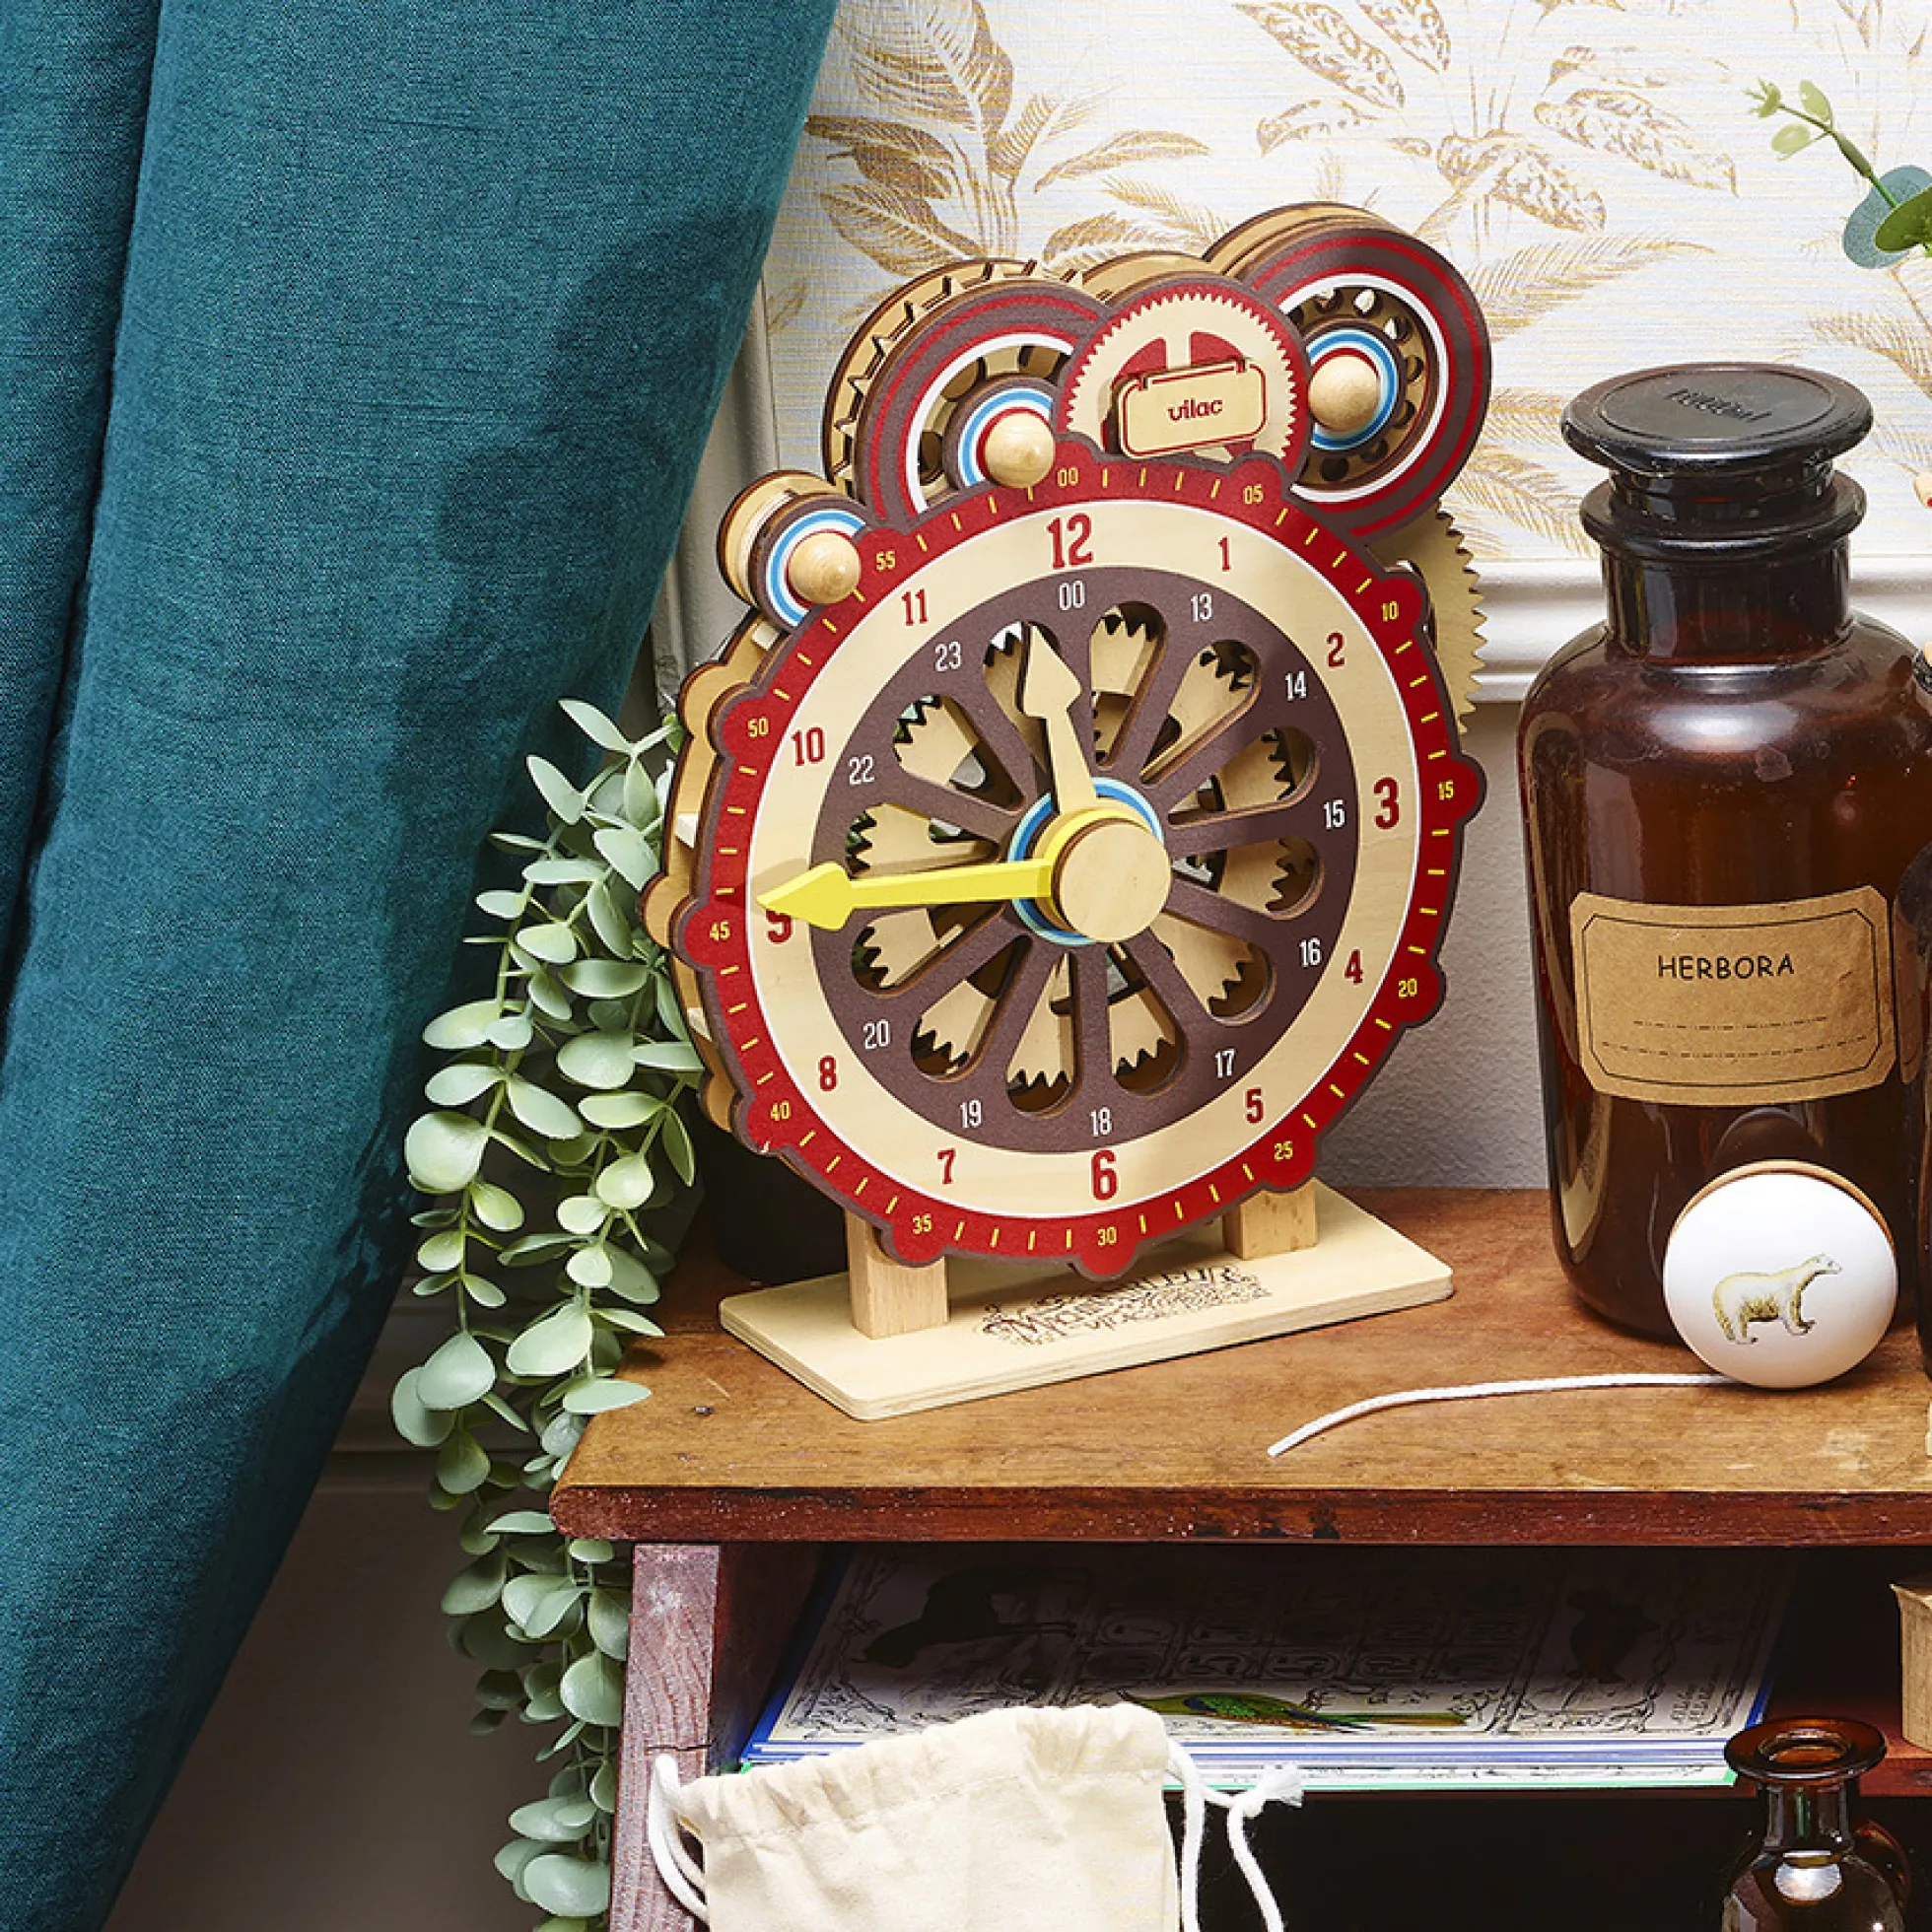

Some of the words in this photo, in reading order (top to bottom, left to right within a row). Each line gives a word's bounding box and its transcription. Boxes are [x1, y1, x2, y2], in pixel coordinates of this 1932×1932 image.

[1167, 398, 1224, 423] vilac
[1057, 466, 1079, 489] 00
[1242, 483, 1265, 505] 05
[1047, 513, 1093, 570] 12
[1219, 537, 1230, 572] 1
[875, 550, 896, 573] 55
[901, 589, 928, 626] 11
[1059, 580, 1086, 611] 00
[1189, 594, 1214, 625] 13
[1382, 600, 1400, 622] 10
[934, 641, 963, 672] 23
[1328, 632, 1344, 667] 2
[1284, 670, 1307, 701] 14
[747, 716, 769, 738] 50
[792, 726, 825, 766] 10
[847, 754, 875, 787] 22
[1373, 778, 1400, 829] 3
[1438, 780, 1454, 800] 15
[1323, 798, 1346, 830] 15
[709, 920, 730, 941] 45
[1298, 936, 1321, 968] 16
[1346, 949, 1362, 984] 4
[1657, 953, 1796, 980] HERBORA
[1398, 977, 1417, 999] 20
[862, 1018, 891, 1050] 20
[818, 1055, 837, 1092] 8
[1214, 1048, 1235, 1078] 17
[770, 1100, 792, 1122] 40
[959, 1099, 982, 1130] 19
[1246, 1087, 1265, 1124] 5
[1088, 1106, 1113, 1138] 18
[1274, 1140, 1293, 1161] 25
[937, 1148, 956, 1185] 7
[1090, 1148, 1118, 1202] 6
[912, 1212, 932, 1235] 35
[1097, 1226, 1118, 1247] 30
